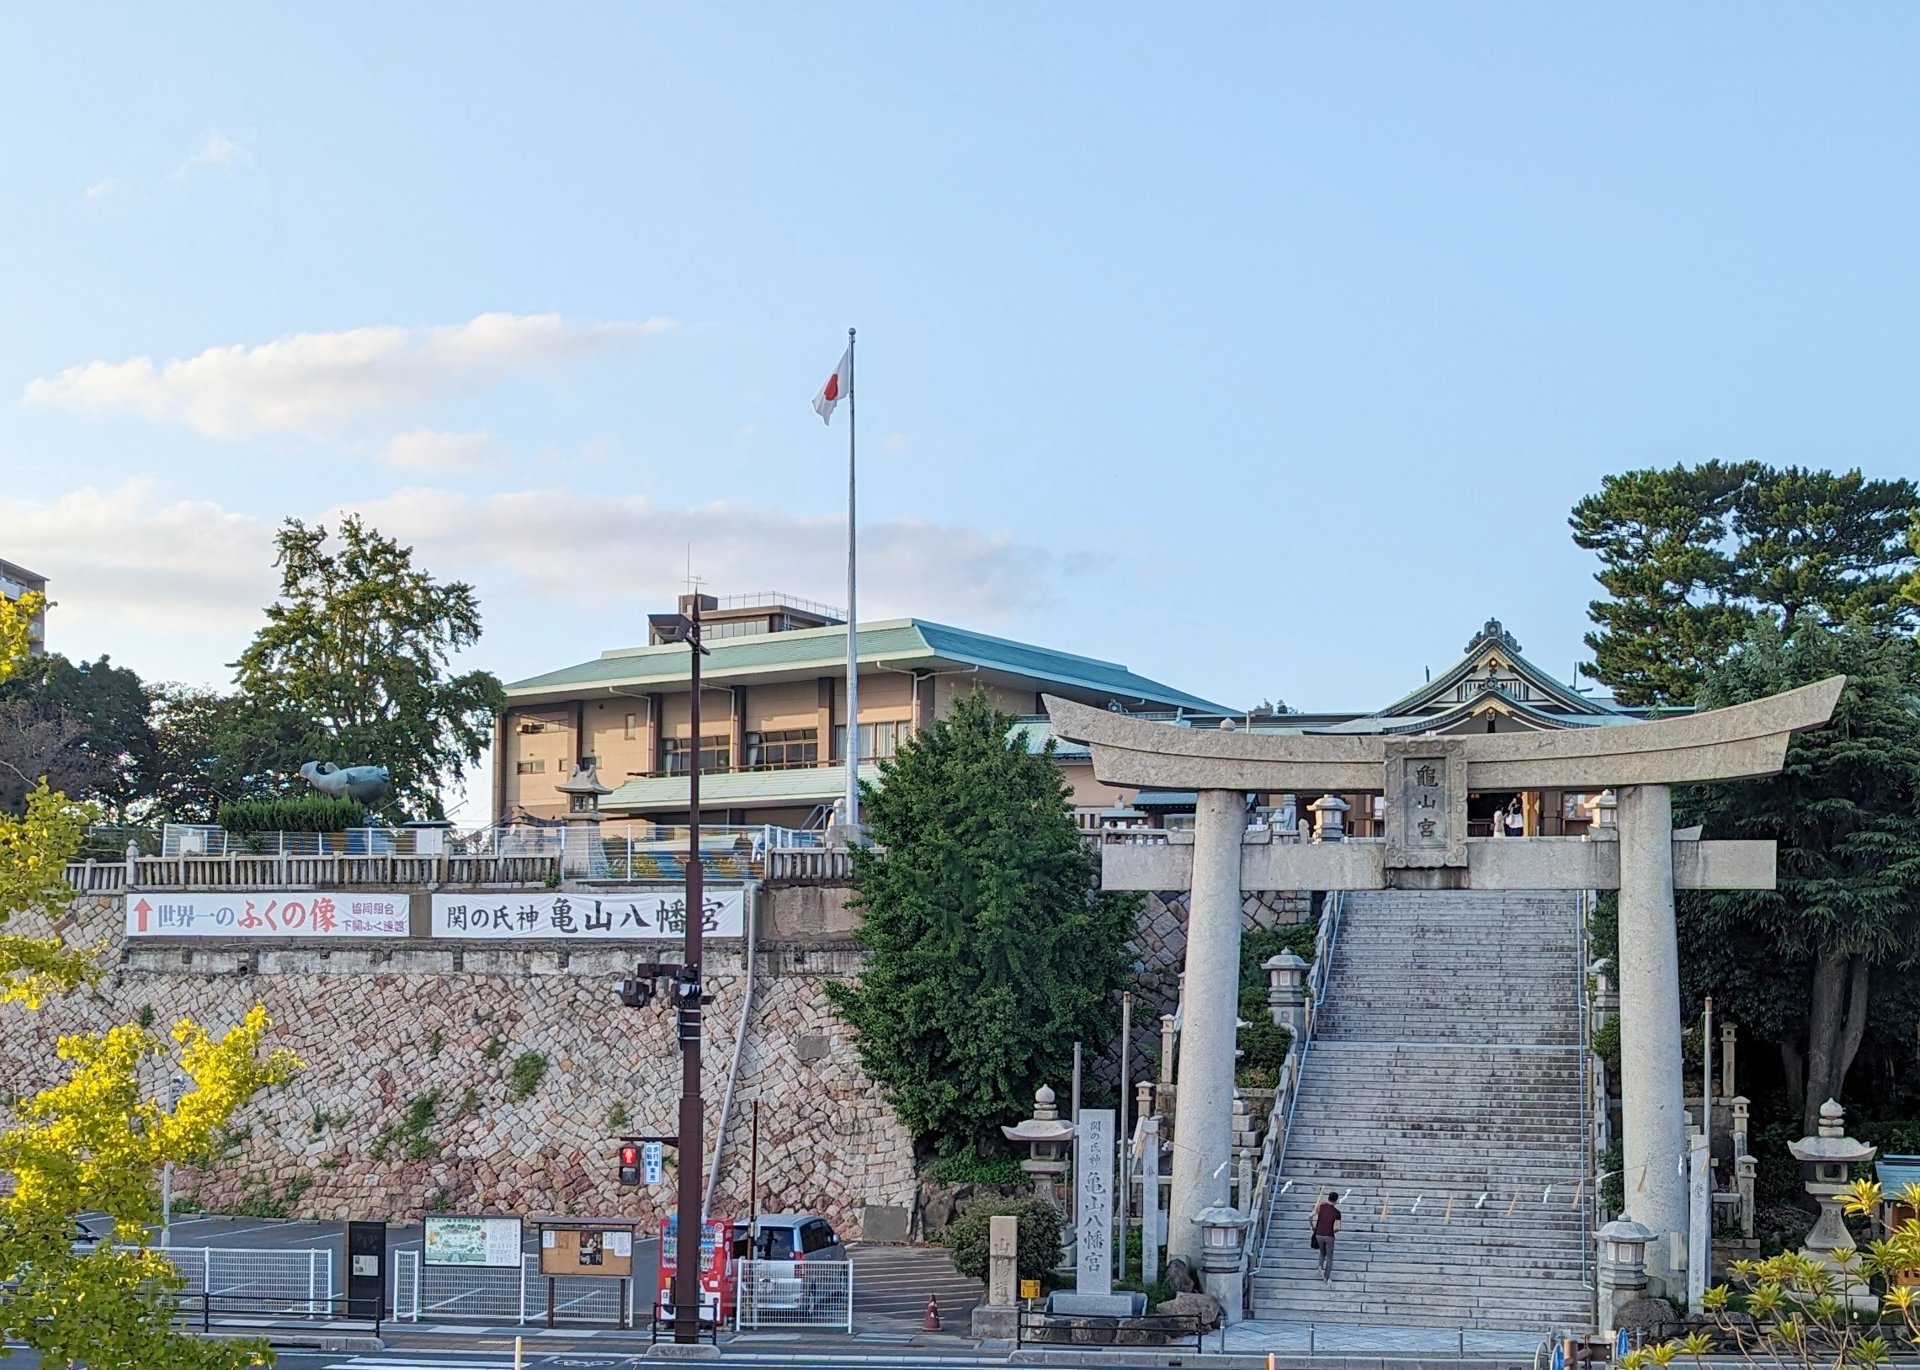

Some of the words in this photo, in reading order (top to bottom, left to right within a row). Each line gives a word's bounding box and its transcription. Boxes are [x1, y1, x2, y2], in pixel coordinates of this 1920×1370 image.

[157, 898, 340, 933] 世界一のふくの像
